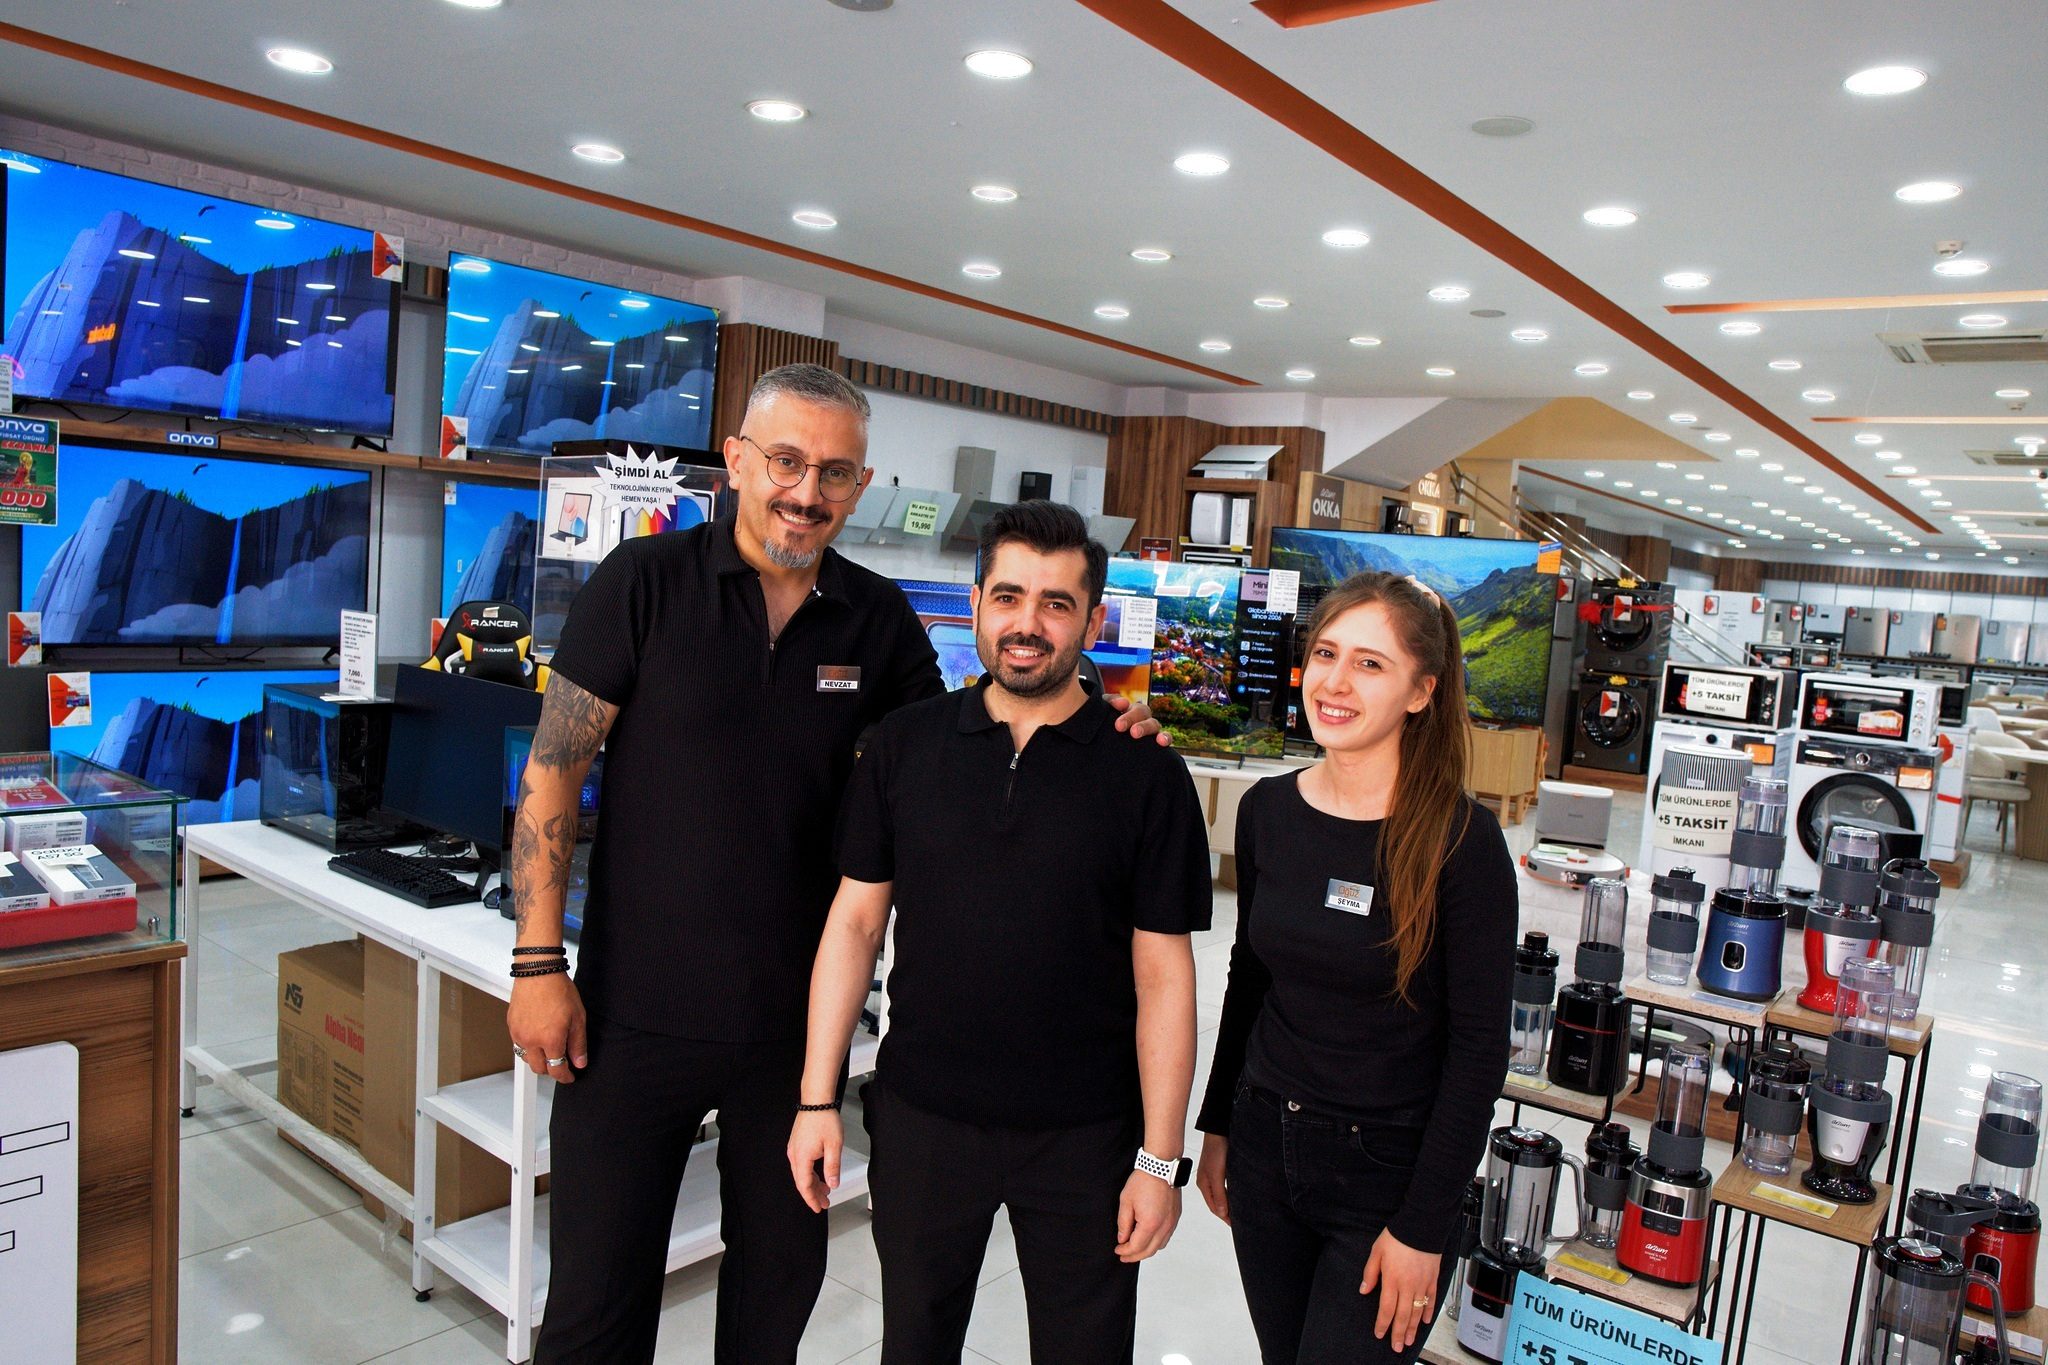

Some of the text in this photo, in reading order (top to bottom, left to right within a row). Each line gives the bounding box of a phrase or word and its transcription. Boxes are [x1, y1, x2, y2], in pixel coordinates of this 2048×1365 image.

[614, 464, 669, 480] ŞİMDİ AL
[610, 484, 673, 494] TEKNOLOJİNİN KEYFİNİ
[1418, 479, 1440, 499] OKKA
[621, 495, 641, 503] HEMEN
[642, 496, 657, 504] YAŞA
[1312, 498, 1340, 519] OKKA
[1706, 678, 1745, 688] ÜRÜNLERDE
[1705, 691, 1742, 702] TAKSİT
[1659, 793, 1732, 808] TÜM ÜRÜNLERDE
[1659, 814, 1729, 830] +5 TAKSİT
[1672, 836, 1705, 847] İMKANI
[1521, 1291, 1565, 1323] TÜM
